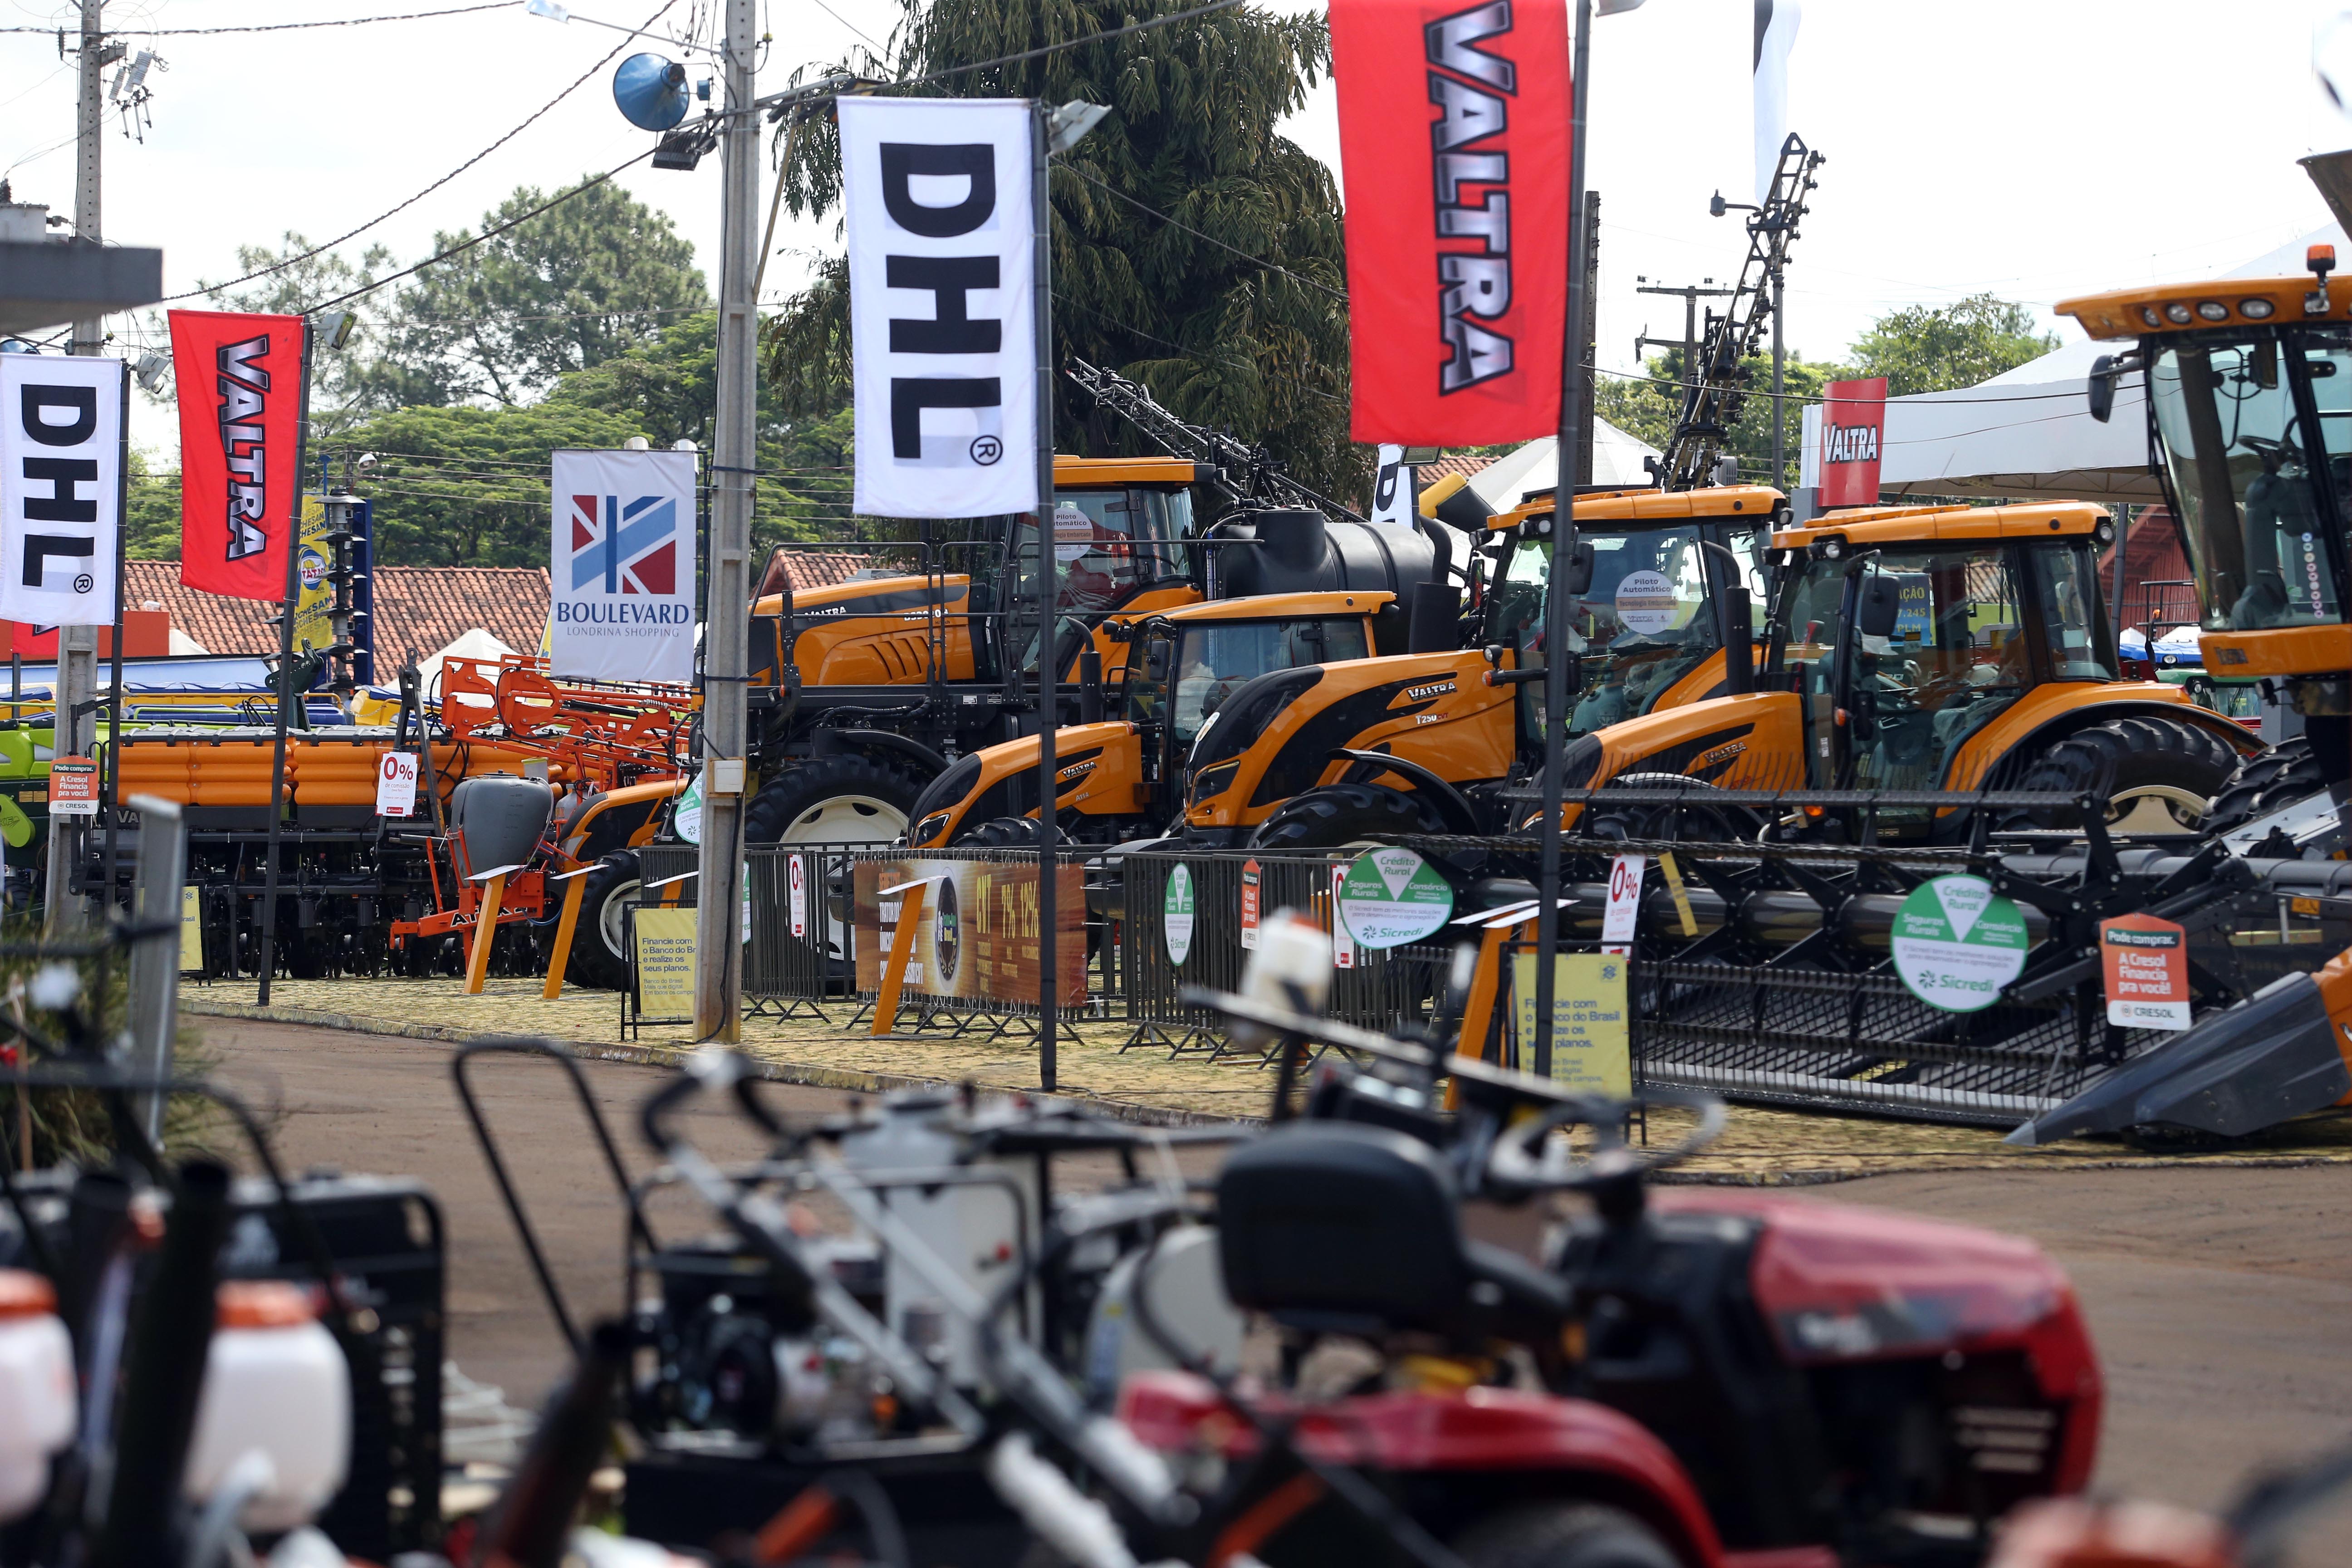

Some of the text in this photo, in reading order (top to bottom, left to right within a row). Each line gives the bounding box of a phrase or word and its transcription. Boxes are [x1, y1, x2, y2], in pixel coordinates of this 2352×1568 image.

[1423, 0, 1518, 397] VALTRA
[216, 333, 271, 562] VALTRA
[1823, 423, 1877, 463] VALTRA
[558, 603, 689, 624] BOULEVARD
[567, 627, 679, 637] LONDRINA SHOPPING
[1407, 682, 1457, 701] VALTRA
[384, 756, 413, 780] 0%
[1062, 760, 1097, 778] VALTRA
[681, 802, 694, 811] Rurais
[1381, 857, 1416, 866] Crédito
[1384, 867, 1411, 876] Rural
[1348, 880, 1382, 890] Seguros
[1409, 882, 1448, 891] Consórcio
[1612, 862, 1638, 902] 0%
[1351, 889, 1378, 897] Rurais
[1943, 886, 1986, 899] Crédito
[976, 874, 992, 934] CVT
[1020, 880, 1039, 938] 12%
[1001, 883, 1016, 939] 7%
[1903, 913, 1945, 926] Seguros
[1379, 928, 1424, 938] Sicredi
[1906, 924, 1940, 936] Rurais
[1975, 920, 2023, 933] Consórcio
[2107, 931, 2176, 946] Pode comprar.
[2118, 952, 2166, 967] A Cresol
[664, 965, 691, 973] planos.
[2119, 966, 2168, 981] Financia
[1940, 974, 1995, 993] Sicredi
[2118, 981, 2172, 995] pra você!
[1573, 1000, 1597, 1009] com
[1573, 1012, 1587, 1021] do
[1589, 1011, 1620, 1021] Brasil
[2134, 1007, 2175, 1018] CRESOL
[1525, 1027, 1585, 1035] e os
[1555, 1039, 1594, 1050] planos.
